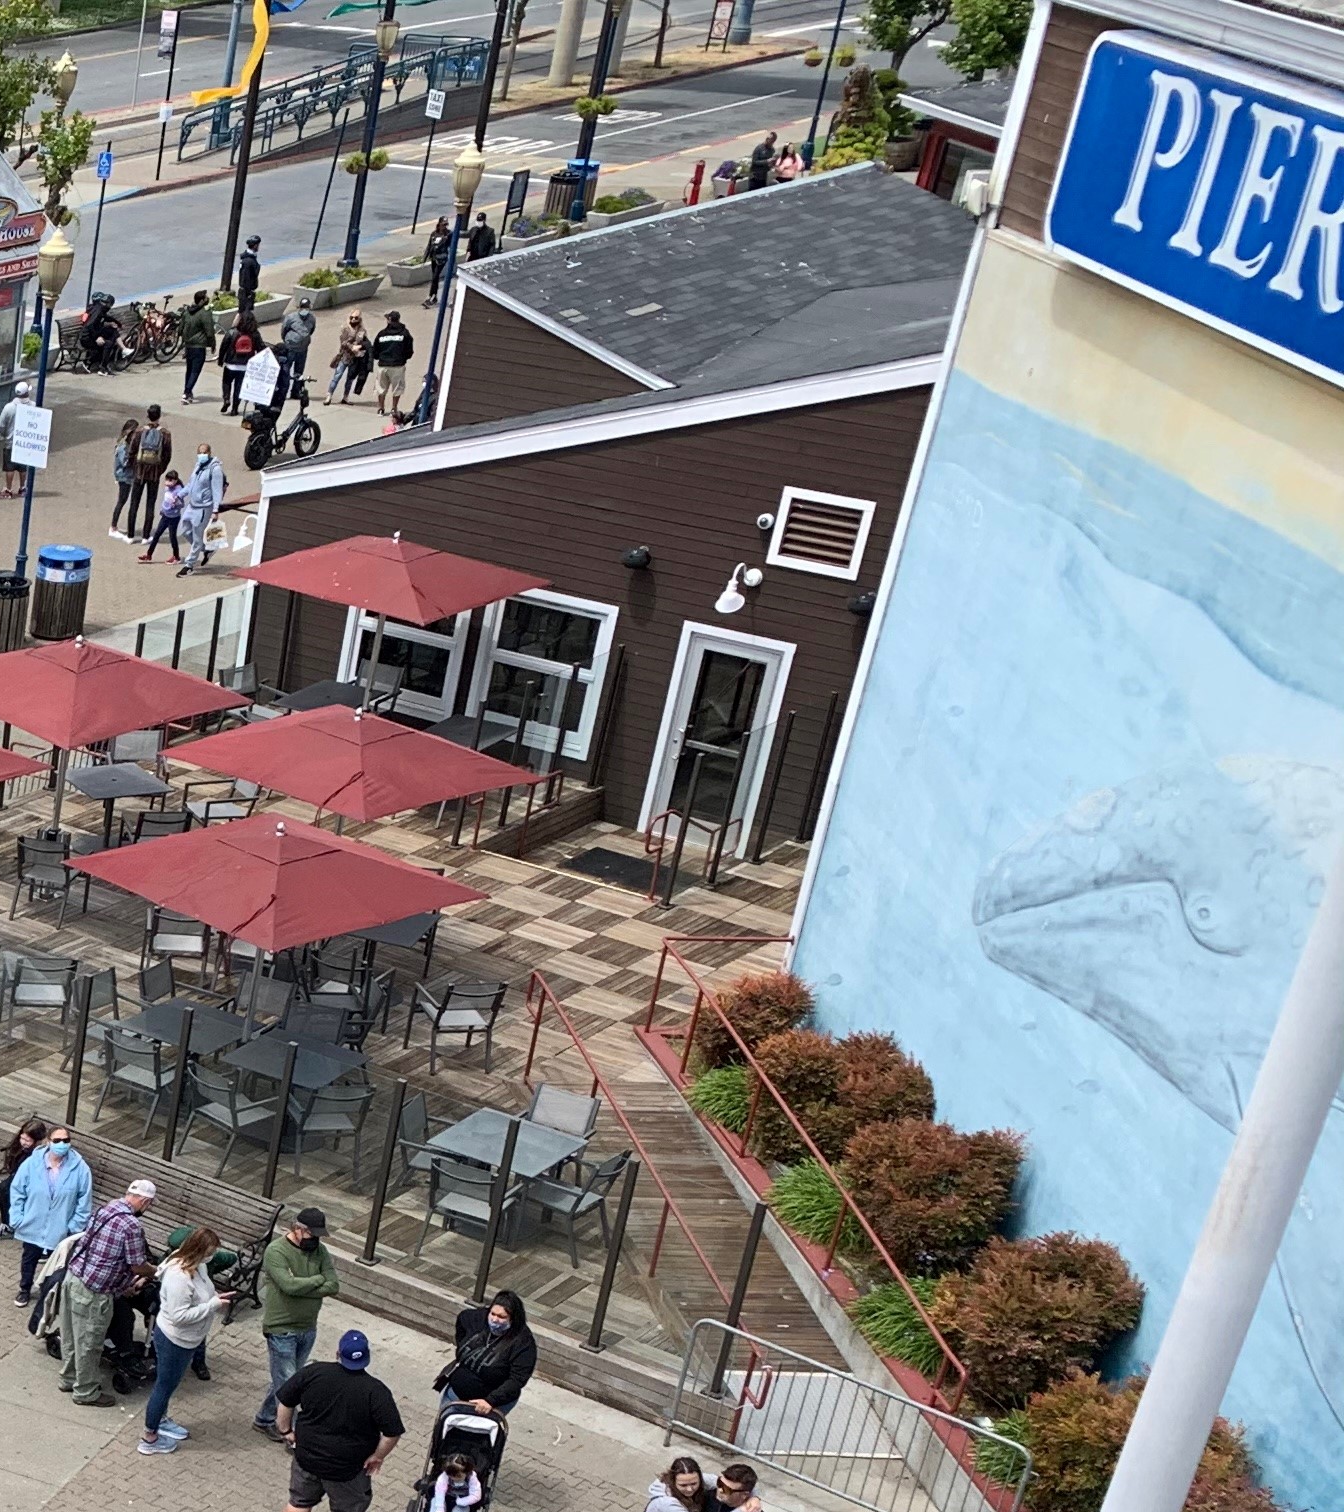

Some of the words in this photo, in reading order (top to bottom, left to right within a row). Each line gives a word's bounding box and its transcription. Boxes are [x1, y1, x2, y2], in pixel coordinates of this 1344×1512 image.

[1113, 68, 1344, 314] PIER
[27, 421, 38, 430] NO
[15, 429, 49, 442] SCOOTERS
[15, 439, 47, 452] ALLOWED
